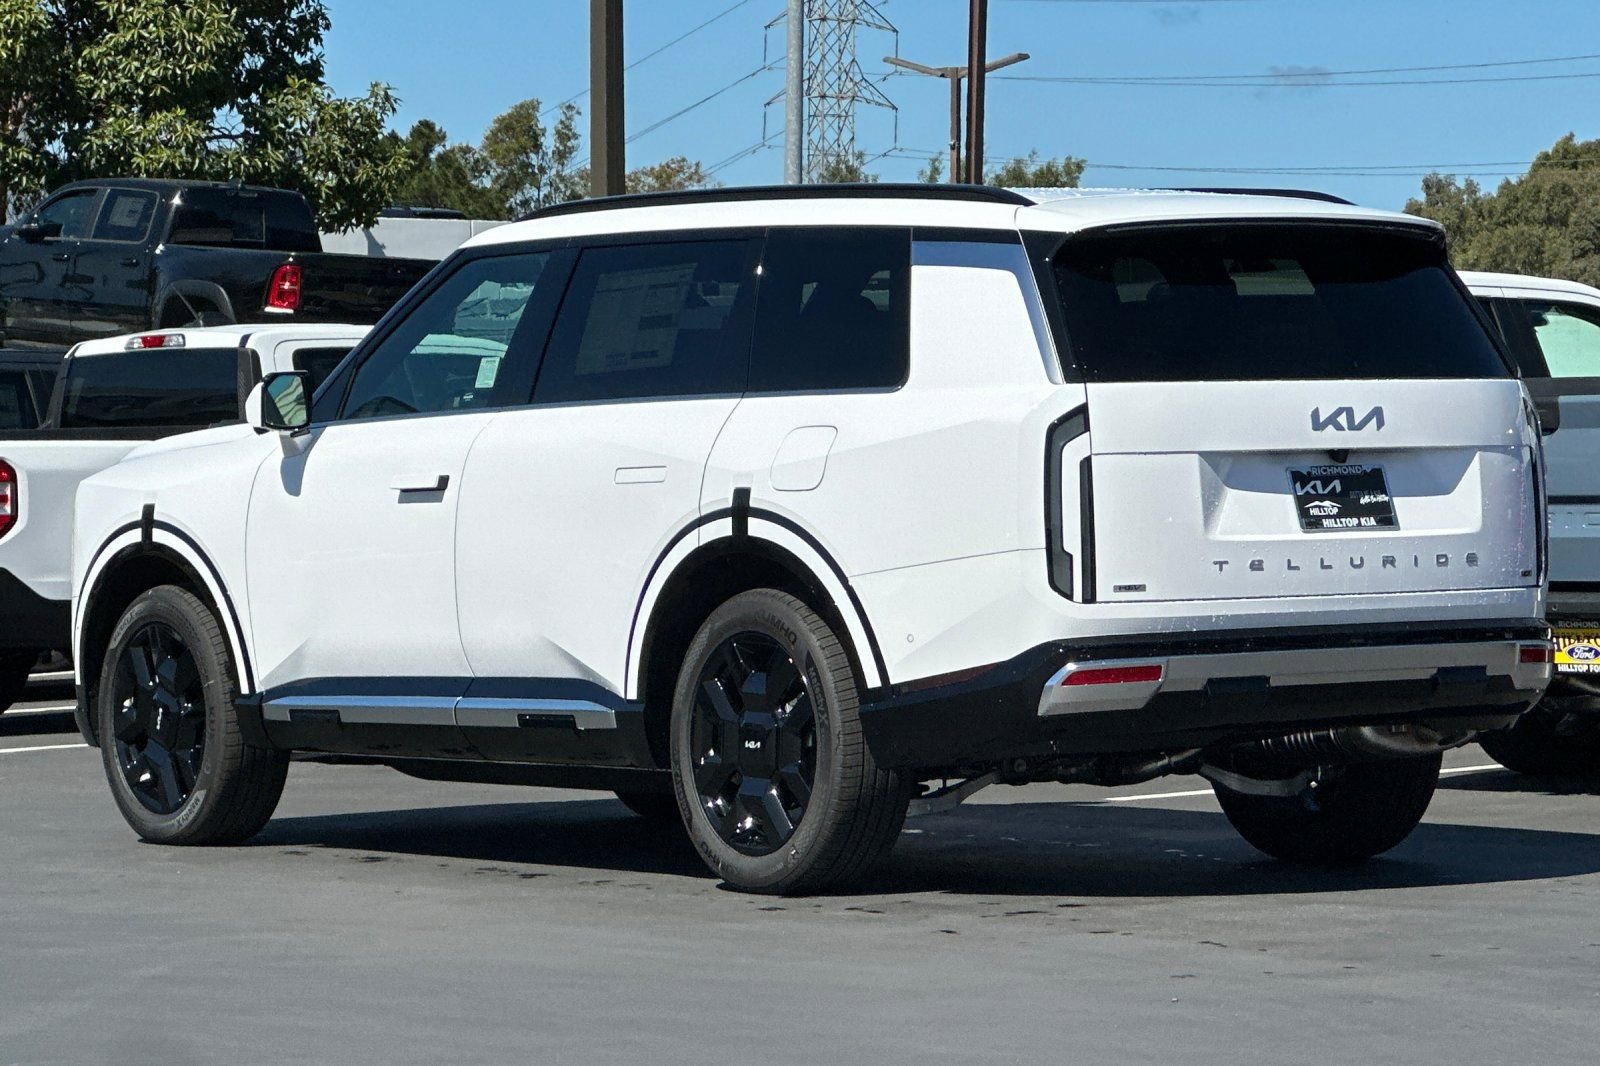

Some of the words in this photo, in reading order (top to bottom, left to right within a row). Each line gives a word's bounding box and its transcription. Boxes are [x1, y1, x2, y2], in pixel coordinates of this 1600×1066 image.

[1311, 406, 1385, 431] KIA
[1311, 467, 1362, 476] RICHMOND
[1295, 479, 1341, 495] KIA
[1309, 507, 1339, 515] HILLTOP
[1322, 518, 1358, 528] HILLTOP
[1361, 516, 1377, 526] KIA
[1213, 553, 1479, 572] TELLURIDE
[1573, 647, 1596, 659] Ford
[1558, 664, 1589, 672] HILLTOP
[744, 740, 761, 749] KIA
